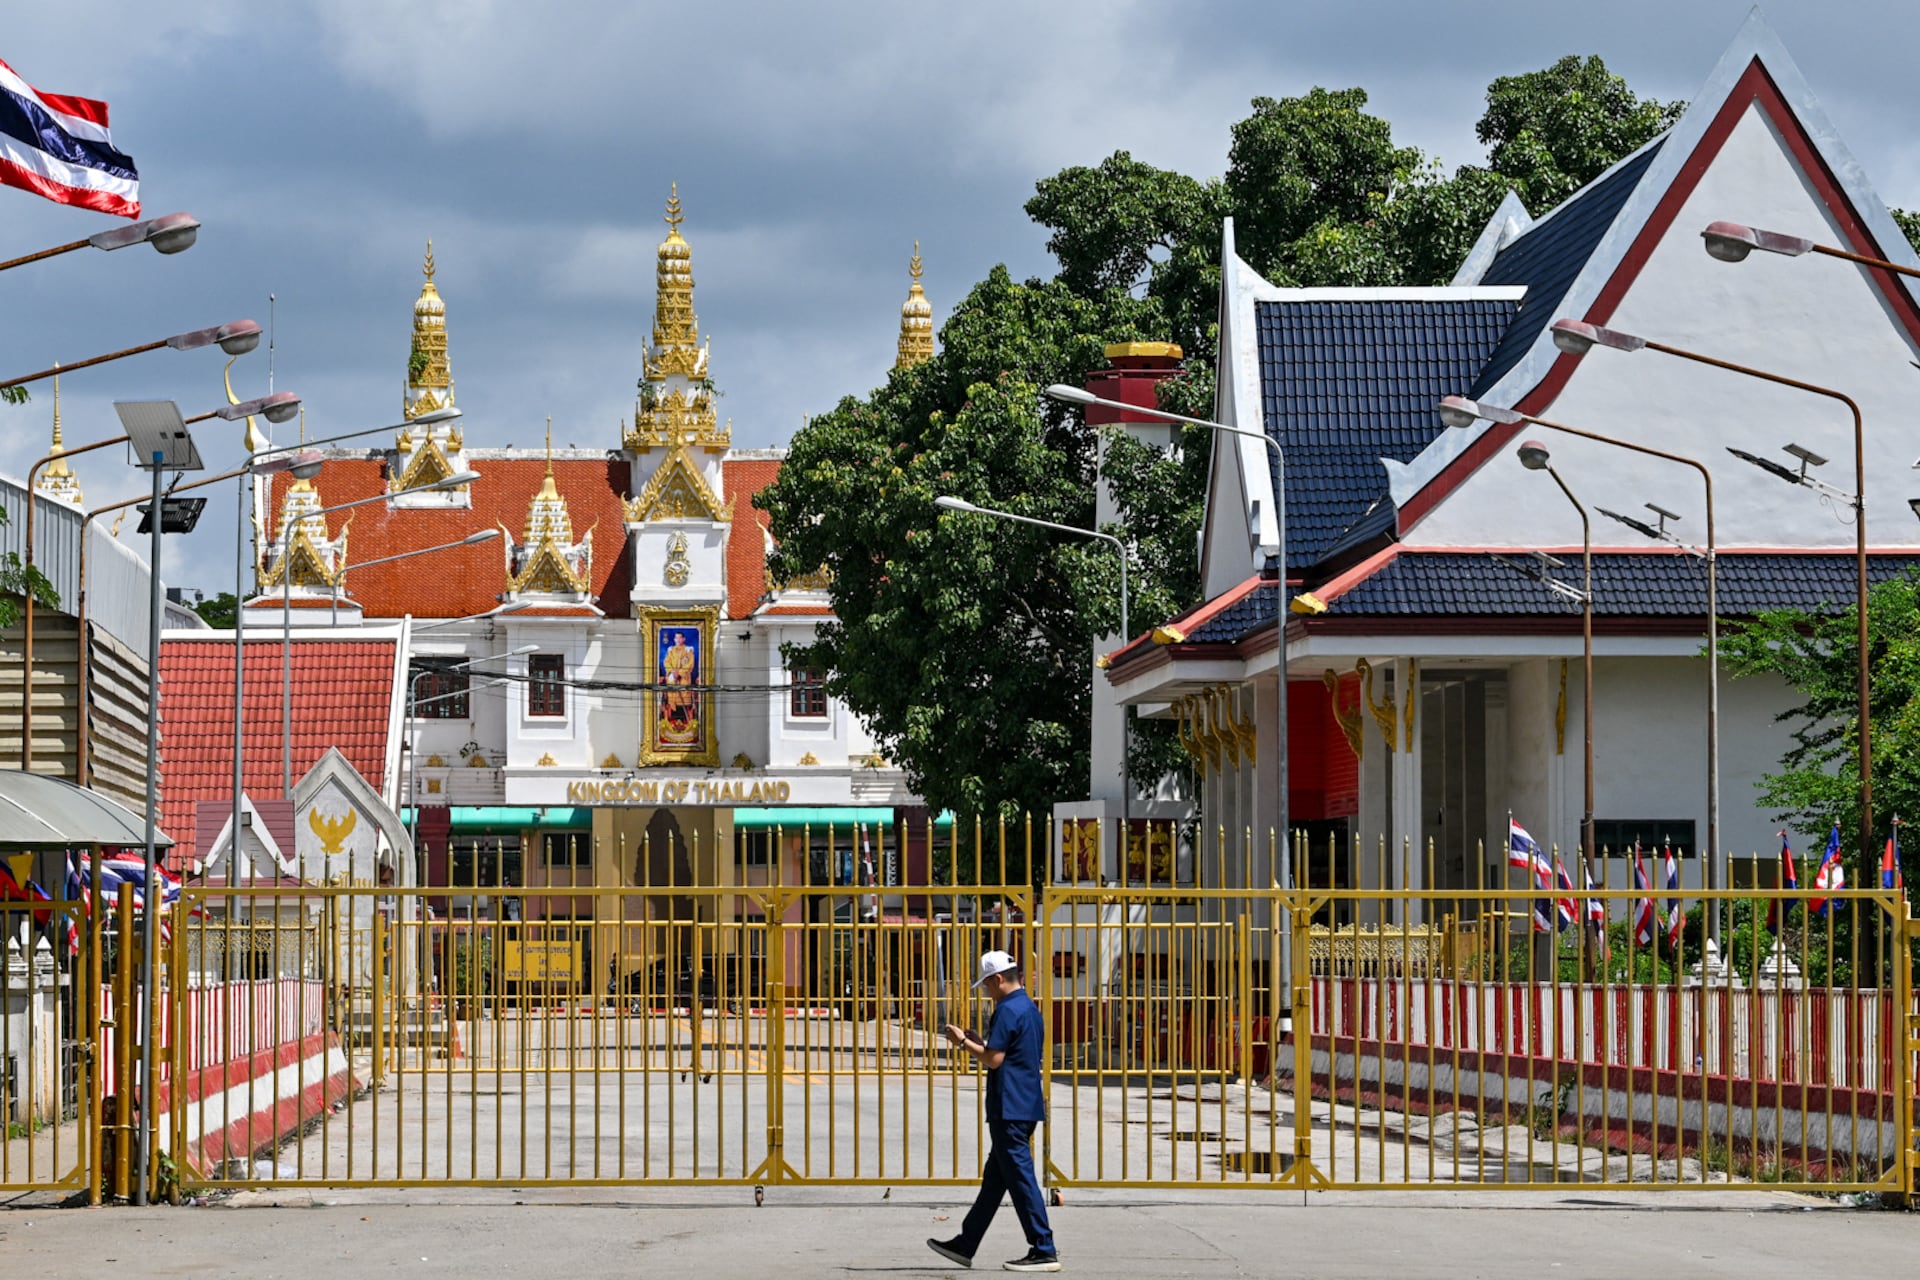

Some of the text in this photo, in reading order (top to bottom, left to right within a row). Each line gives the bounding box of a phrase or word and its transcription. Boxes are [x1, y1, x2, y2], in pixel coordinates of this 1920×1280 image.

[567, 781, 791, 802] KINGDOM OF THAILAND
